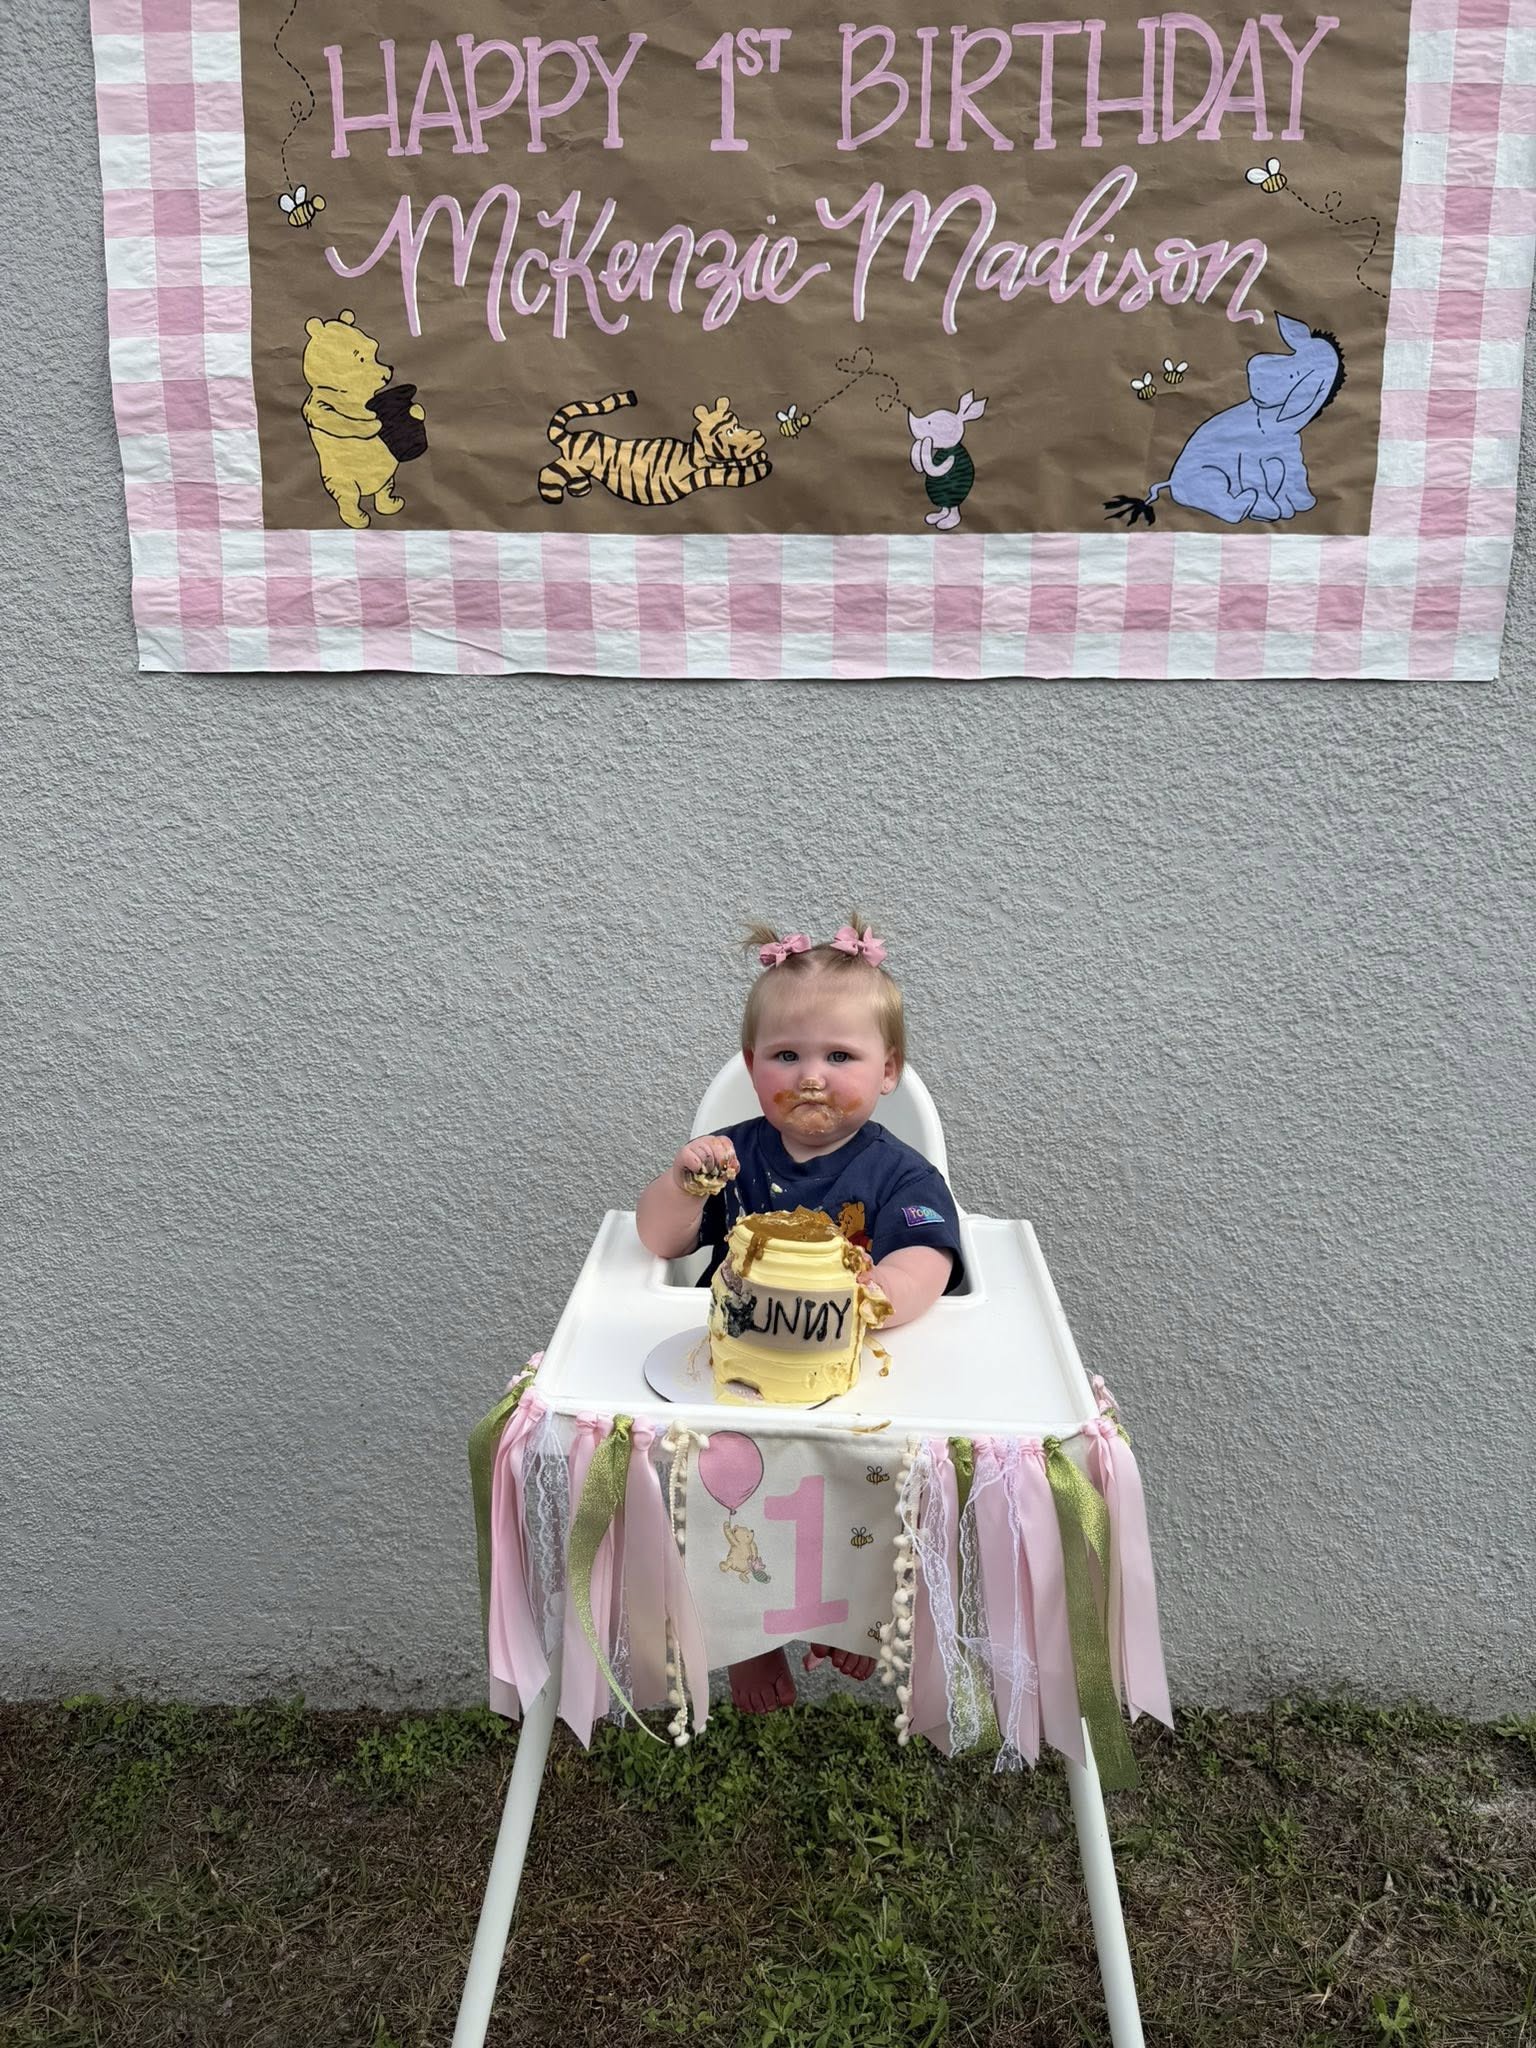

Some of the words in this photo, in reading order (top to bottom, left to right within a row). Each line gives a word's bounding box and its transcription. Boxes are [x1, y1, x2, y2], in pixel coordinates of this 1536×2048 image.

[323, 33, 648, 158] HAPPY
[696, 28, 792, 151] 1ST
[837, 13, 1340, 151] BIRTHDAY
[324, 184, 831, 341] McKenzie
[815, 164, 1268, 335] Madison
[763, 1474, 849, 1635] 1
